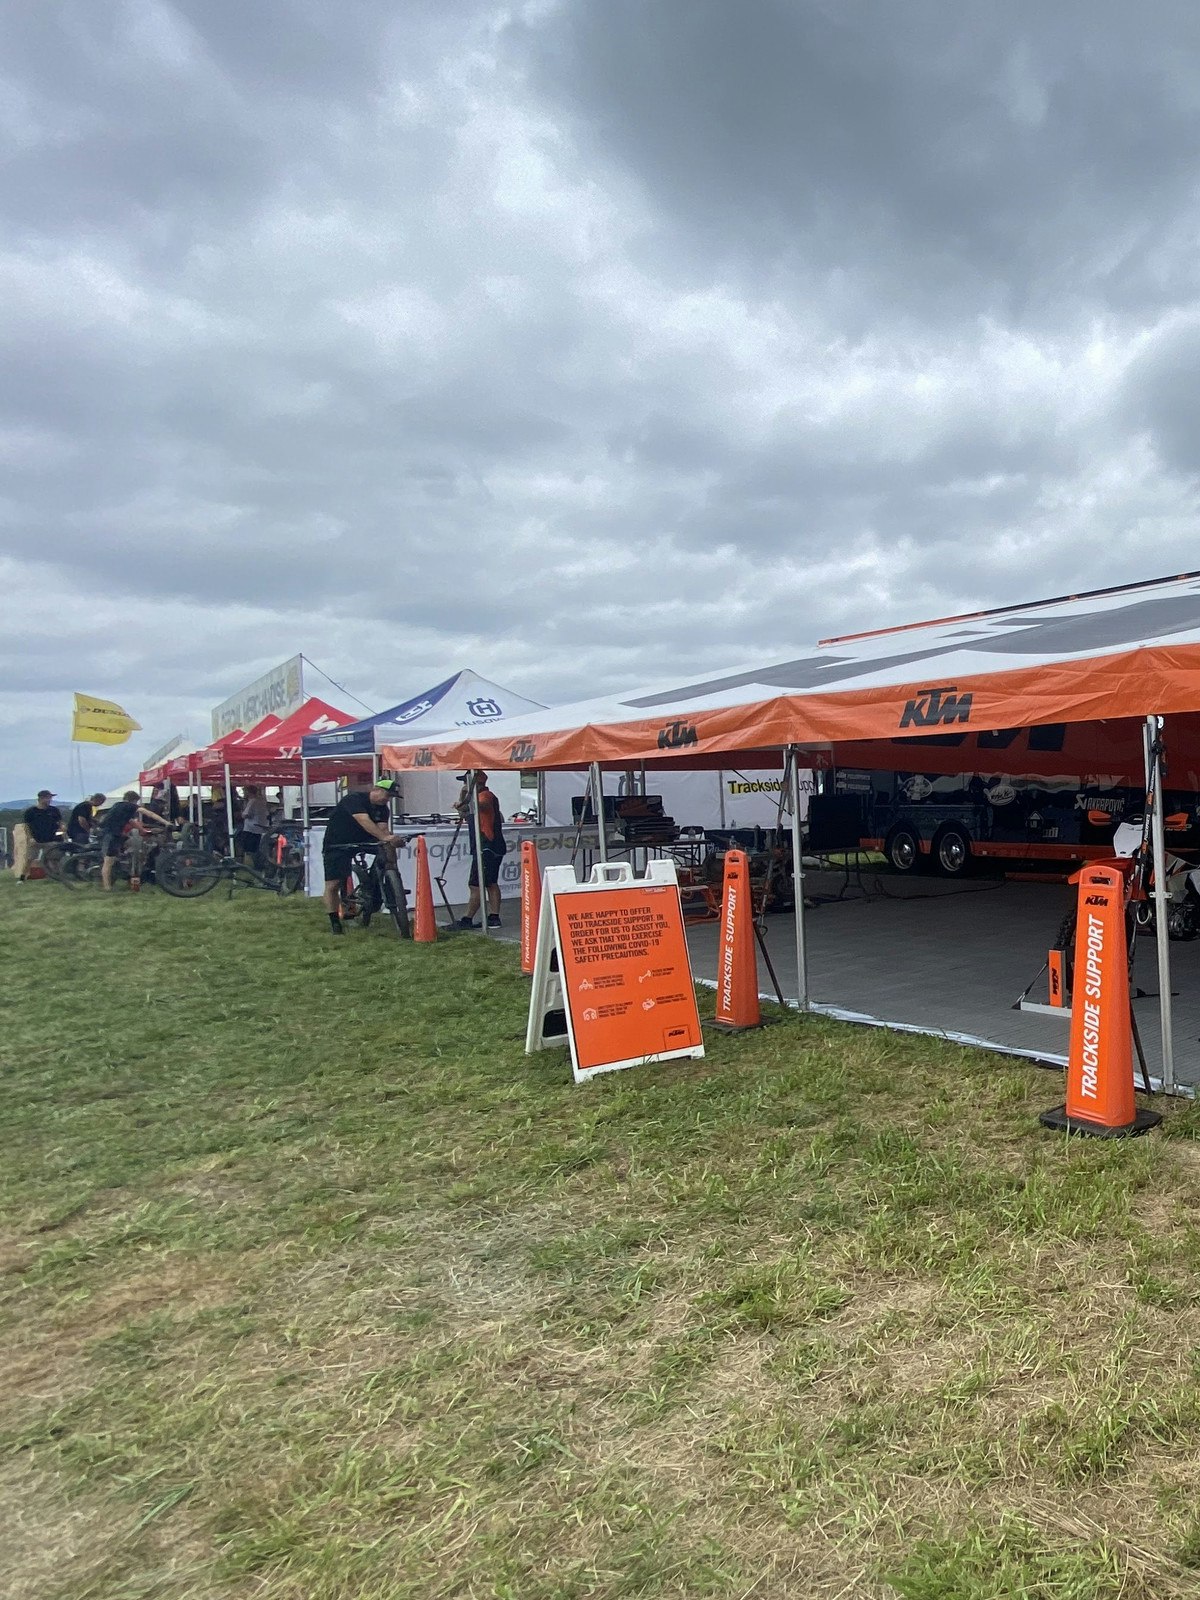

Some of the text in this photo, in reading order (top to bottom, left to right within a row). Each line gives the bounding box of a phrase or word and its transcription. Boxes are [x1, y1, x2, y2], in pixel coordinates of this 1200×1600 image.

[899, 687, 973, 728] KTM
[657, 721, 698, 749] KTM
[414, 748, 432, 766] KTM
[509, 740, 536, 762] KTM
[728, 779, 784, 794] Tracksid
[1084, 894, 1108, 906] KTM
[581, 912, 593, 920] ARE
[595, 909, 618, 918] HAPPY
[630, 907, 650, 915] OFFER
[569, 922, 583, 930] YOU
[585, 918, 621, 928] TRACKSIDE
[570, 928, 594, 938] ORDER
[595, 927, 609, 936] FOR
[632, 922, 653, 931] ASSIST
[585, 937, 598, 945] ASK
[599, 936, 615, 944] THAT
[632, 930, 662, 940] EXERCISE
[574, 939, 660, 955] THE FOLLOWING COVID-19
[723, 885, 737, 1012] TRACKSIDE SUPPORT
[575, 954, 599, 963] SAFETY
[1081, 914, 1104, 1099] TRACKSIDE SUPPORT
